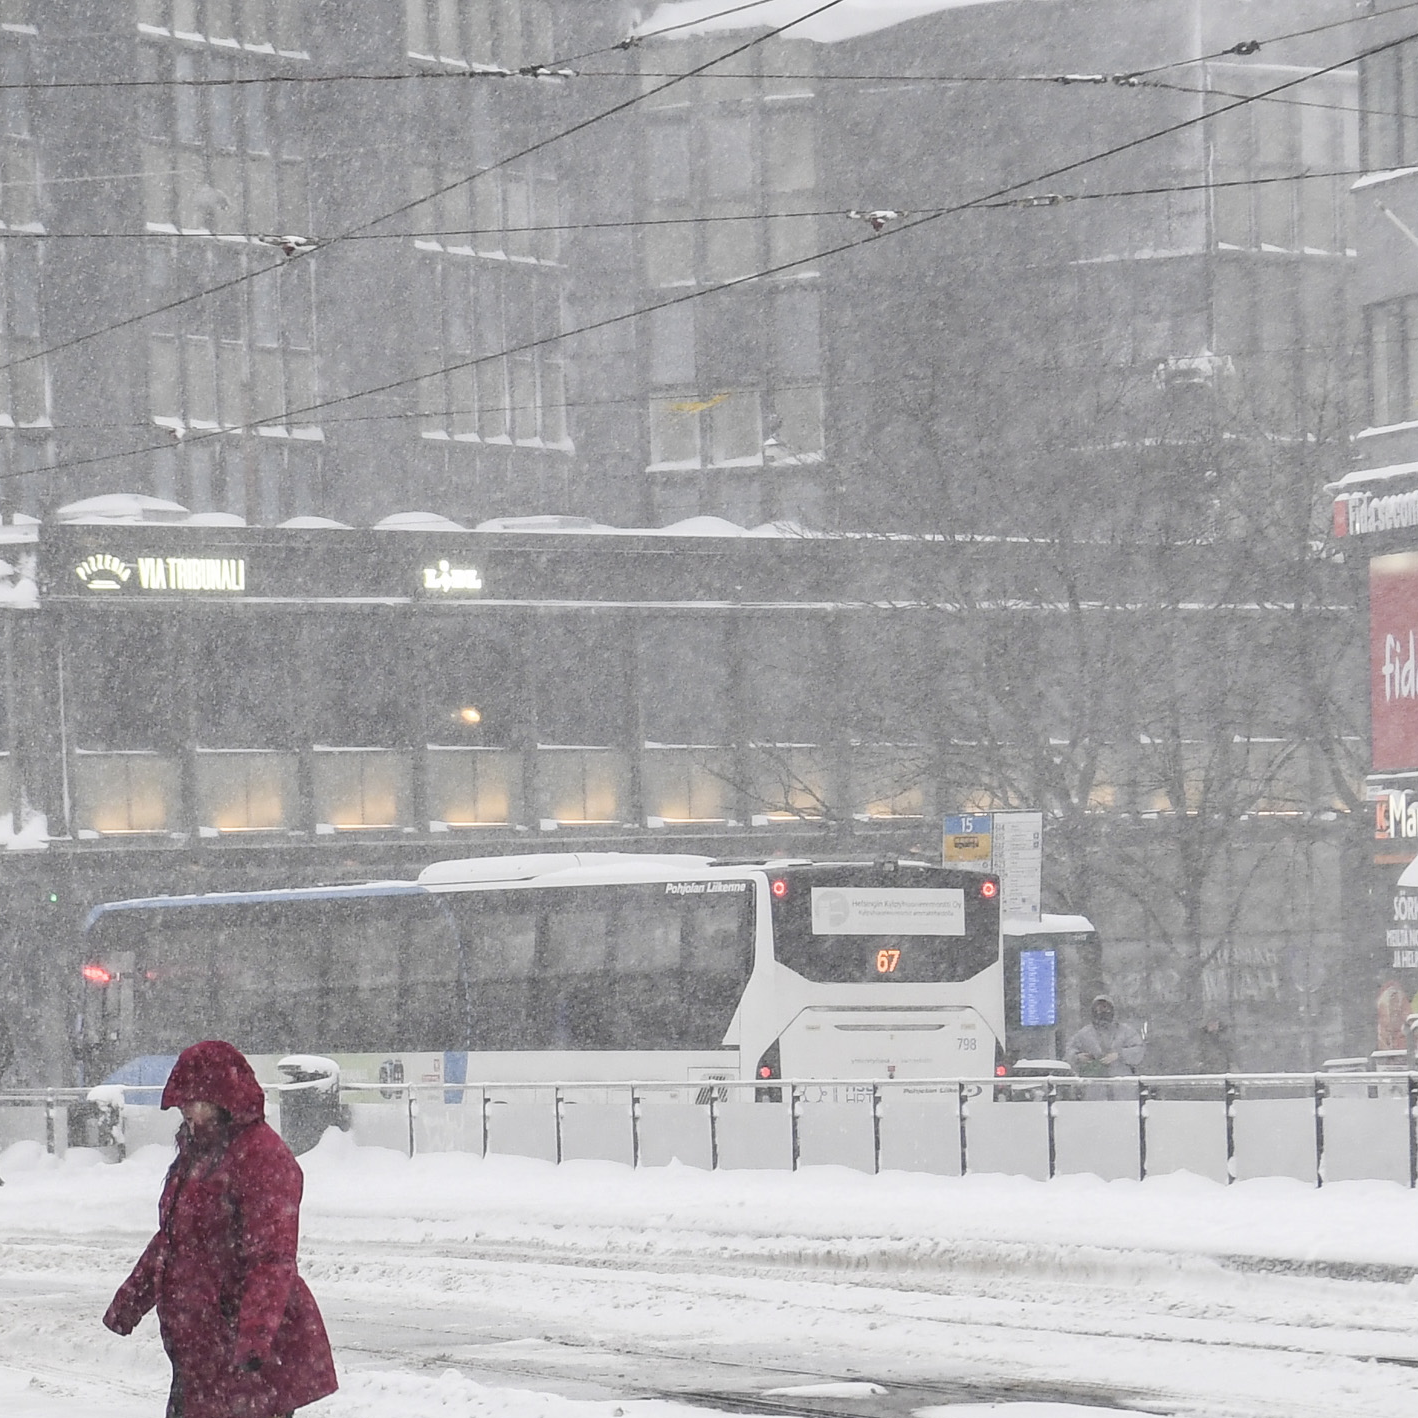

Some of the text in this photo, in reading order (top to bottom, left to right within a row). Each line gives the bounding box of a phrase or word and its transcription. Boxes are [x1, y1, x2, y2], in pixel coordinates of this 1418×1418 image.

[75, 553, 245, 590] PIZZERIA VIA TRIBUNALI
[960, 817, 974, 833] 15
[665, 882, 746, 895] Pohjolan Liikenne
[876, 949, 901, 973] 67
[957, 1037, 977, 1051] 798
